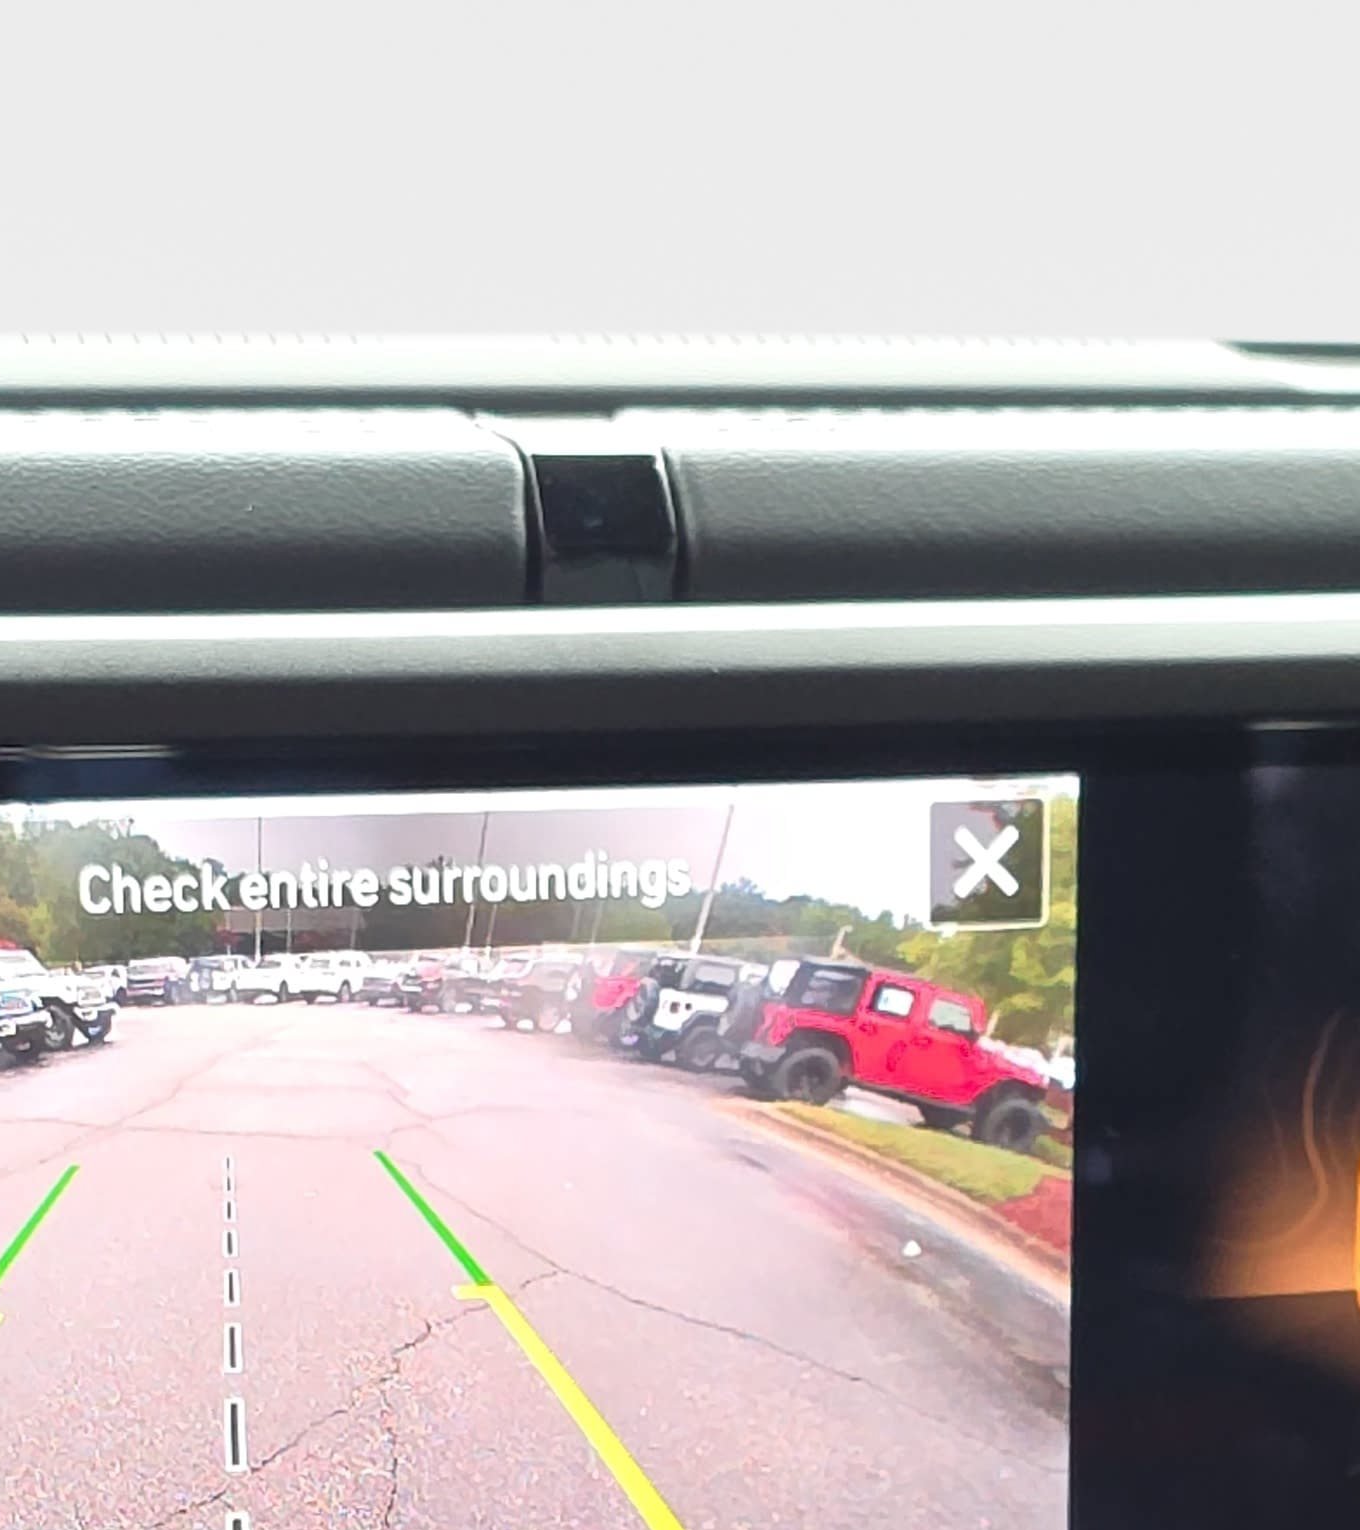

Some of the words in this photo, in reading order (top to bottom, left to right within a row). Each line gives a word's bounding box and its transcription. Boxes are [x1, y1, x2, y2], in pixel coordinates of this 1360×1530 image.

[79, 863, 231, 914] Check
[240, 858, 379, 909] entire
[388, 850, 692, 908] surroundings
